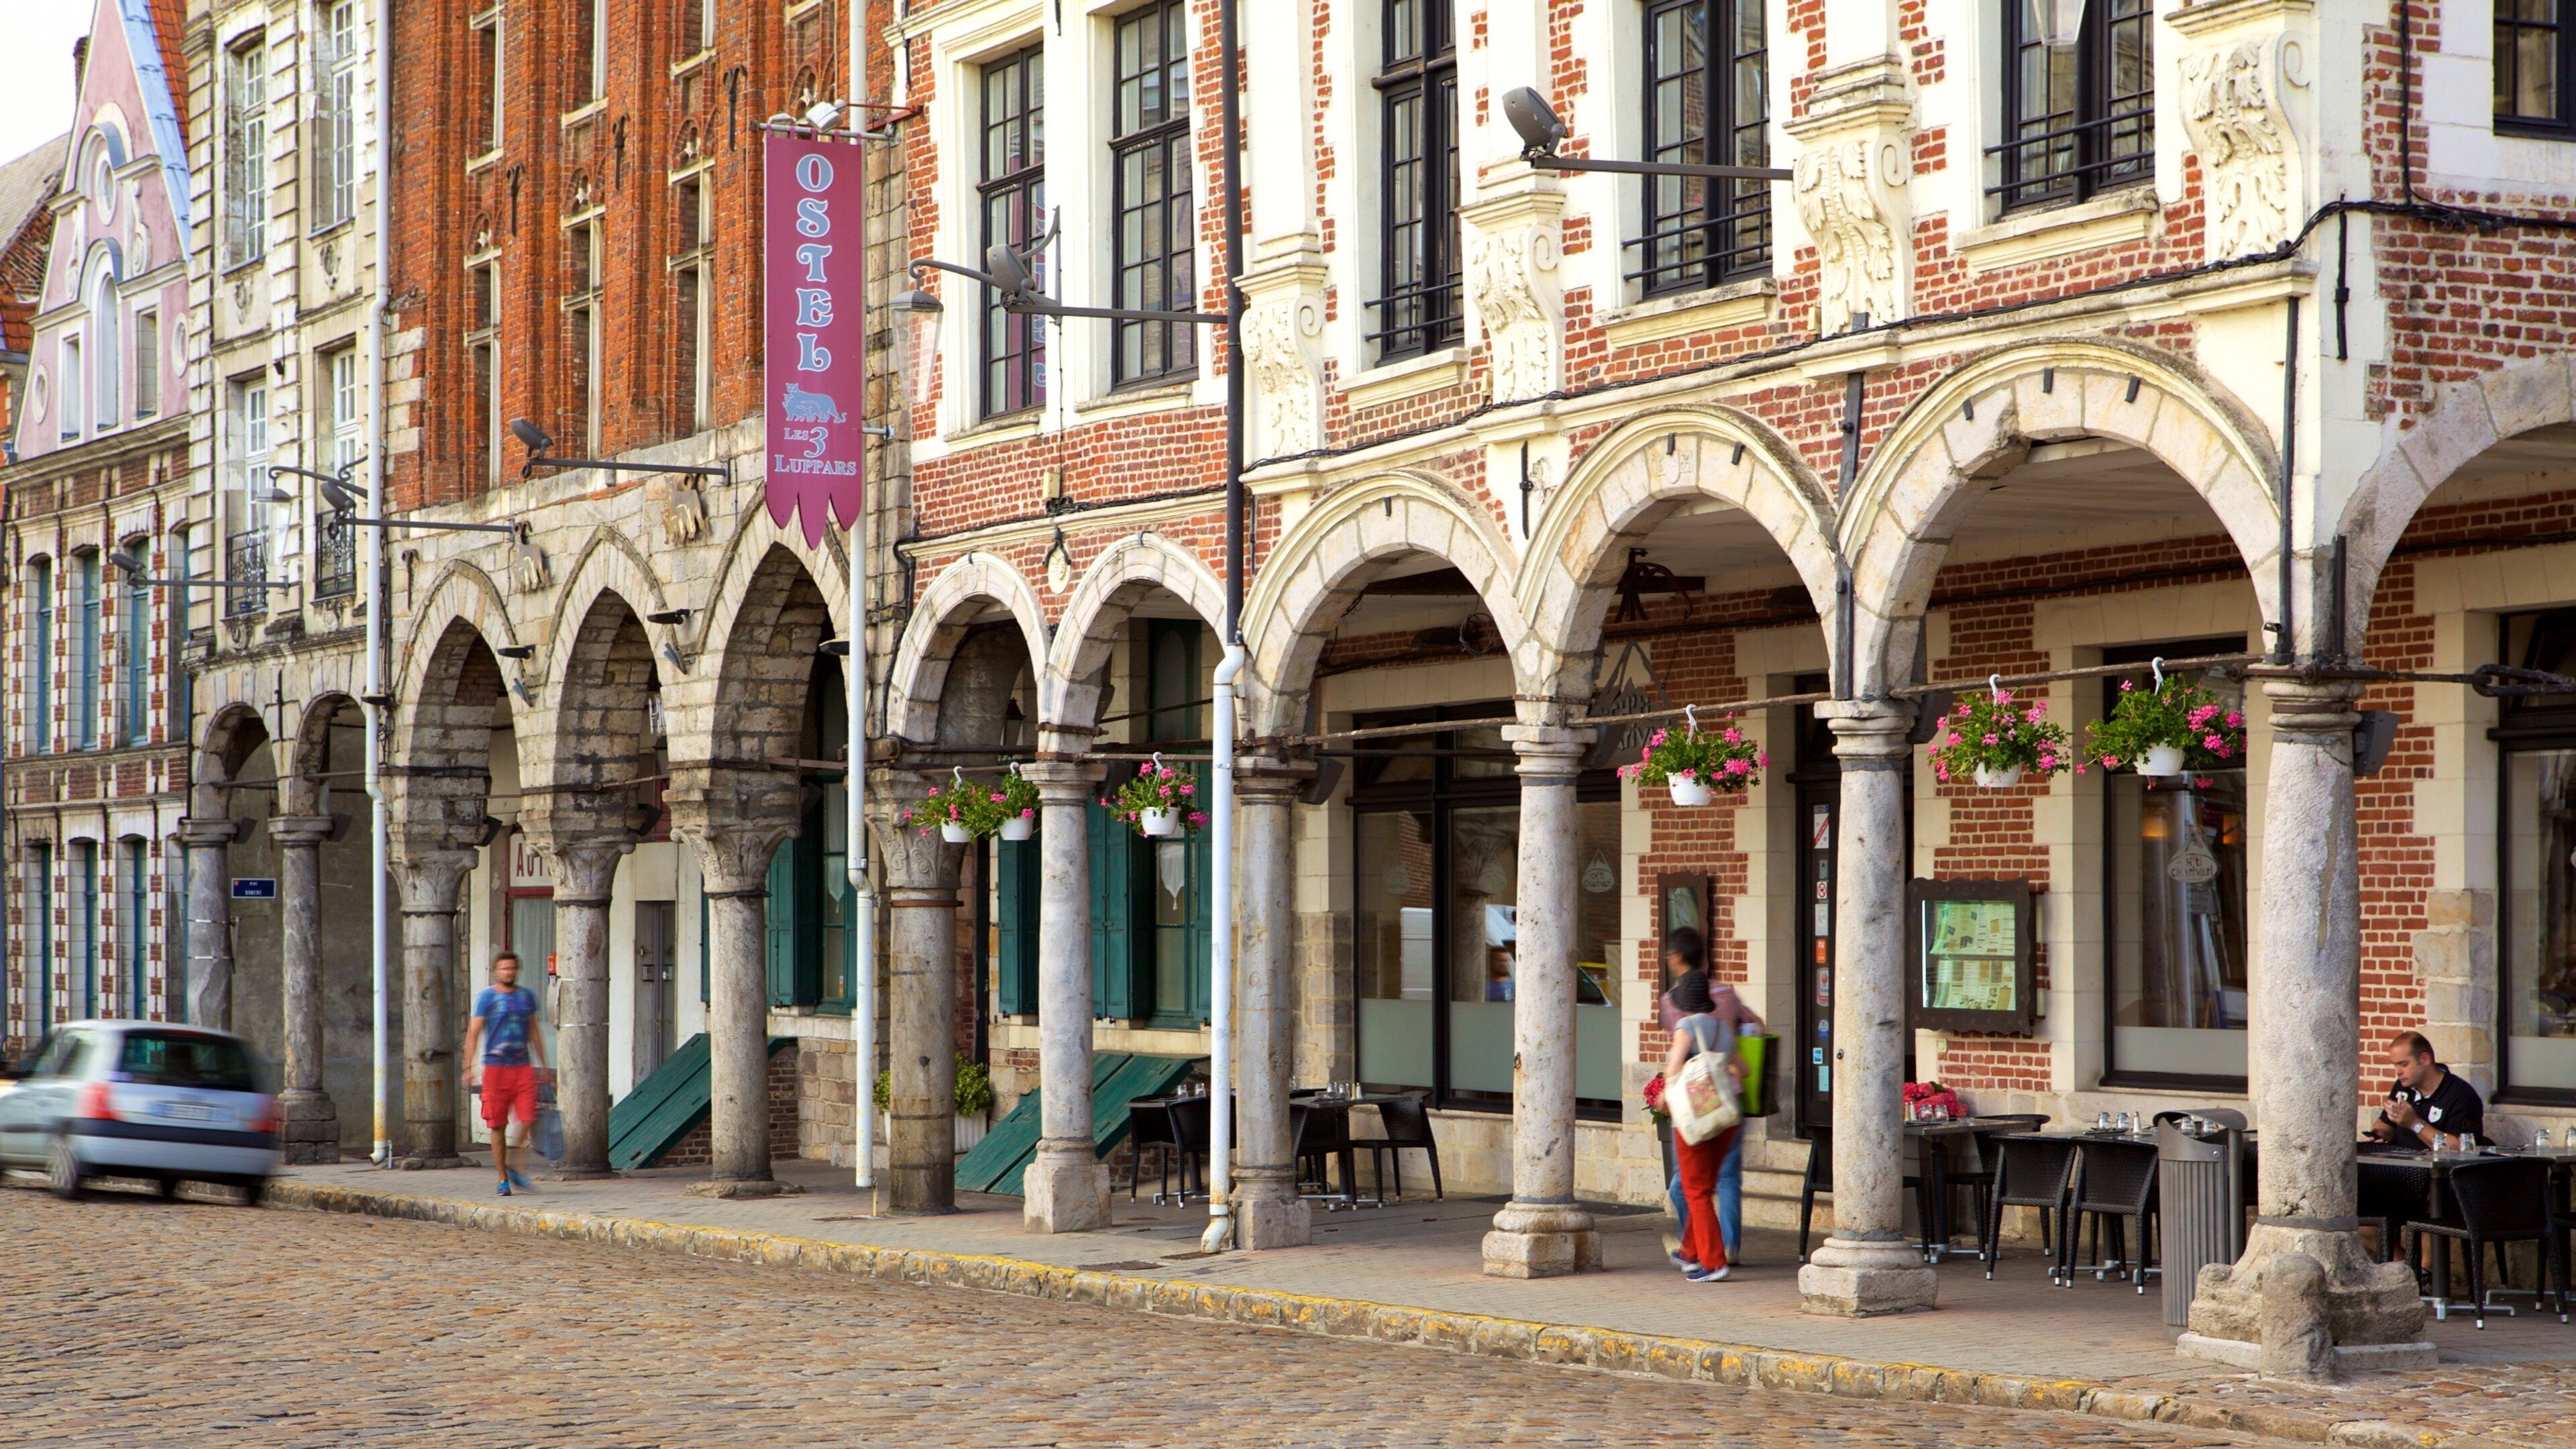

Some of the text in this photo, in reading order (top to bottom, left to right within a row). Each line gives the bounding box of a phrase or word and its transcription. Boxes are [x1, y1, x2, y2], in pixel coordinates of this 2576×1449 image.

[796, 153, 834, 372] OSTEL
[804, 426, 829, 458] 3
[774, 453, 857, 476] LUPPARS
